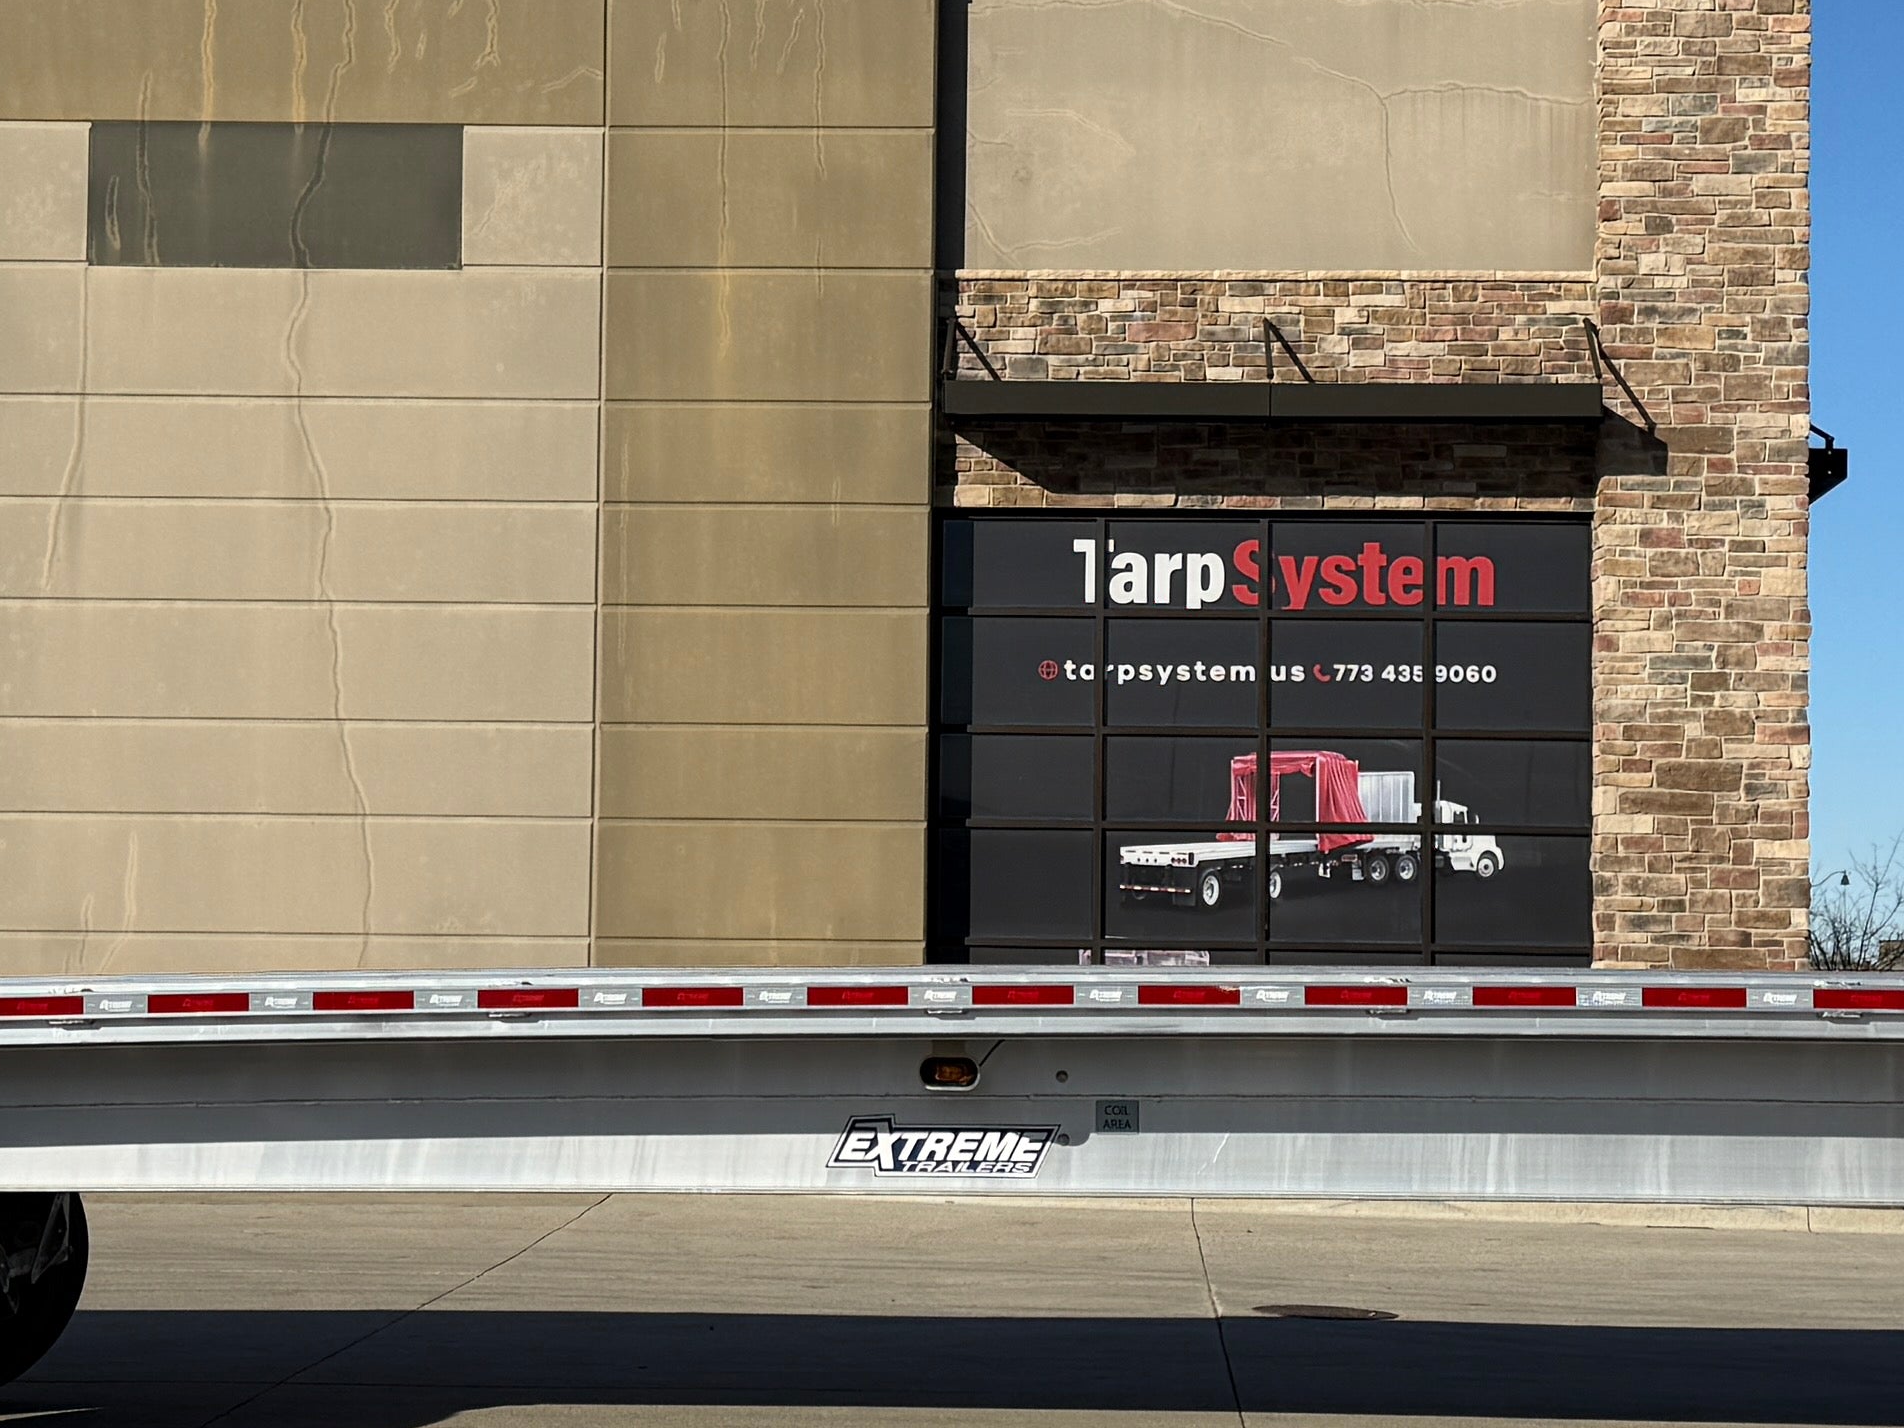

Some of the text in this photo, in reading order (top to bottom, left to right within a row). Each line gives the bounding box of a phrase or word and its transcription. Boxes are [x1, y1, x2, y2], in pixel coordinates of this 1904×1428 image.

[1333, 664, 1374, 683] 773
[1381, 665, 1423, 683] 435
[1435, 665, 1497, 684] 9060
[1104, 1104, 1130, 1117] COIL
[1102, 1119, 1133, 1131] AREA
[838, 1121, 1047, 1170] EXTREME
[901, 1160, 1033, 1174] TRAILERS
